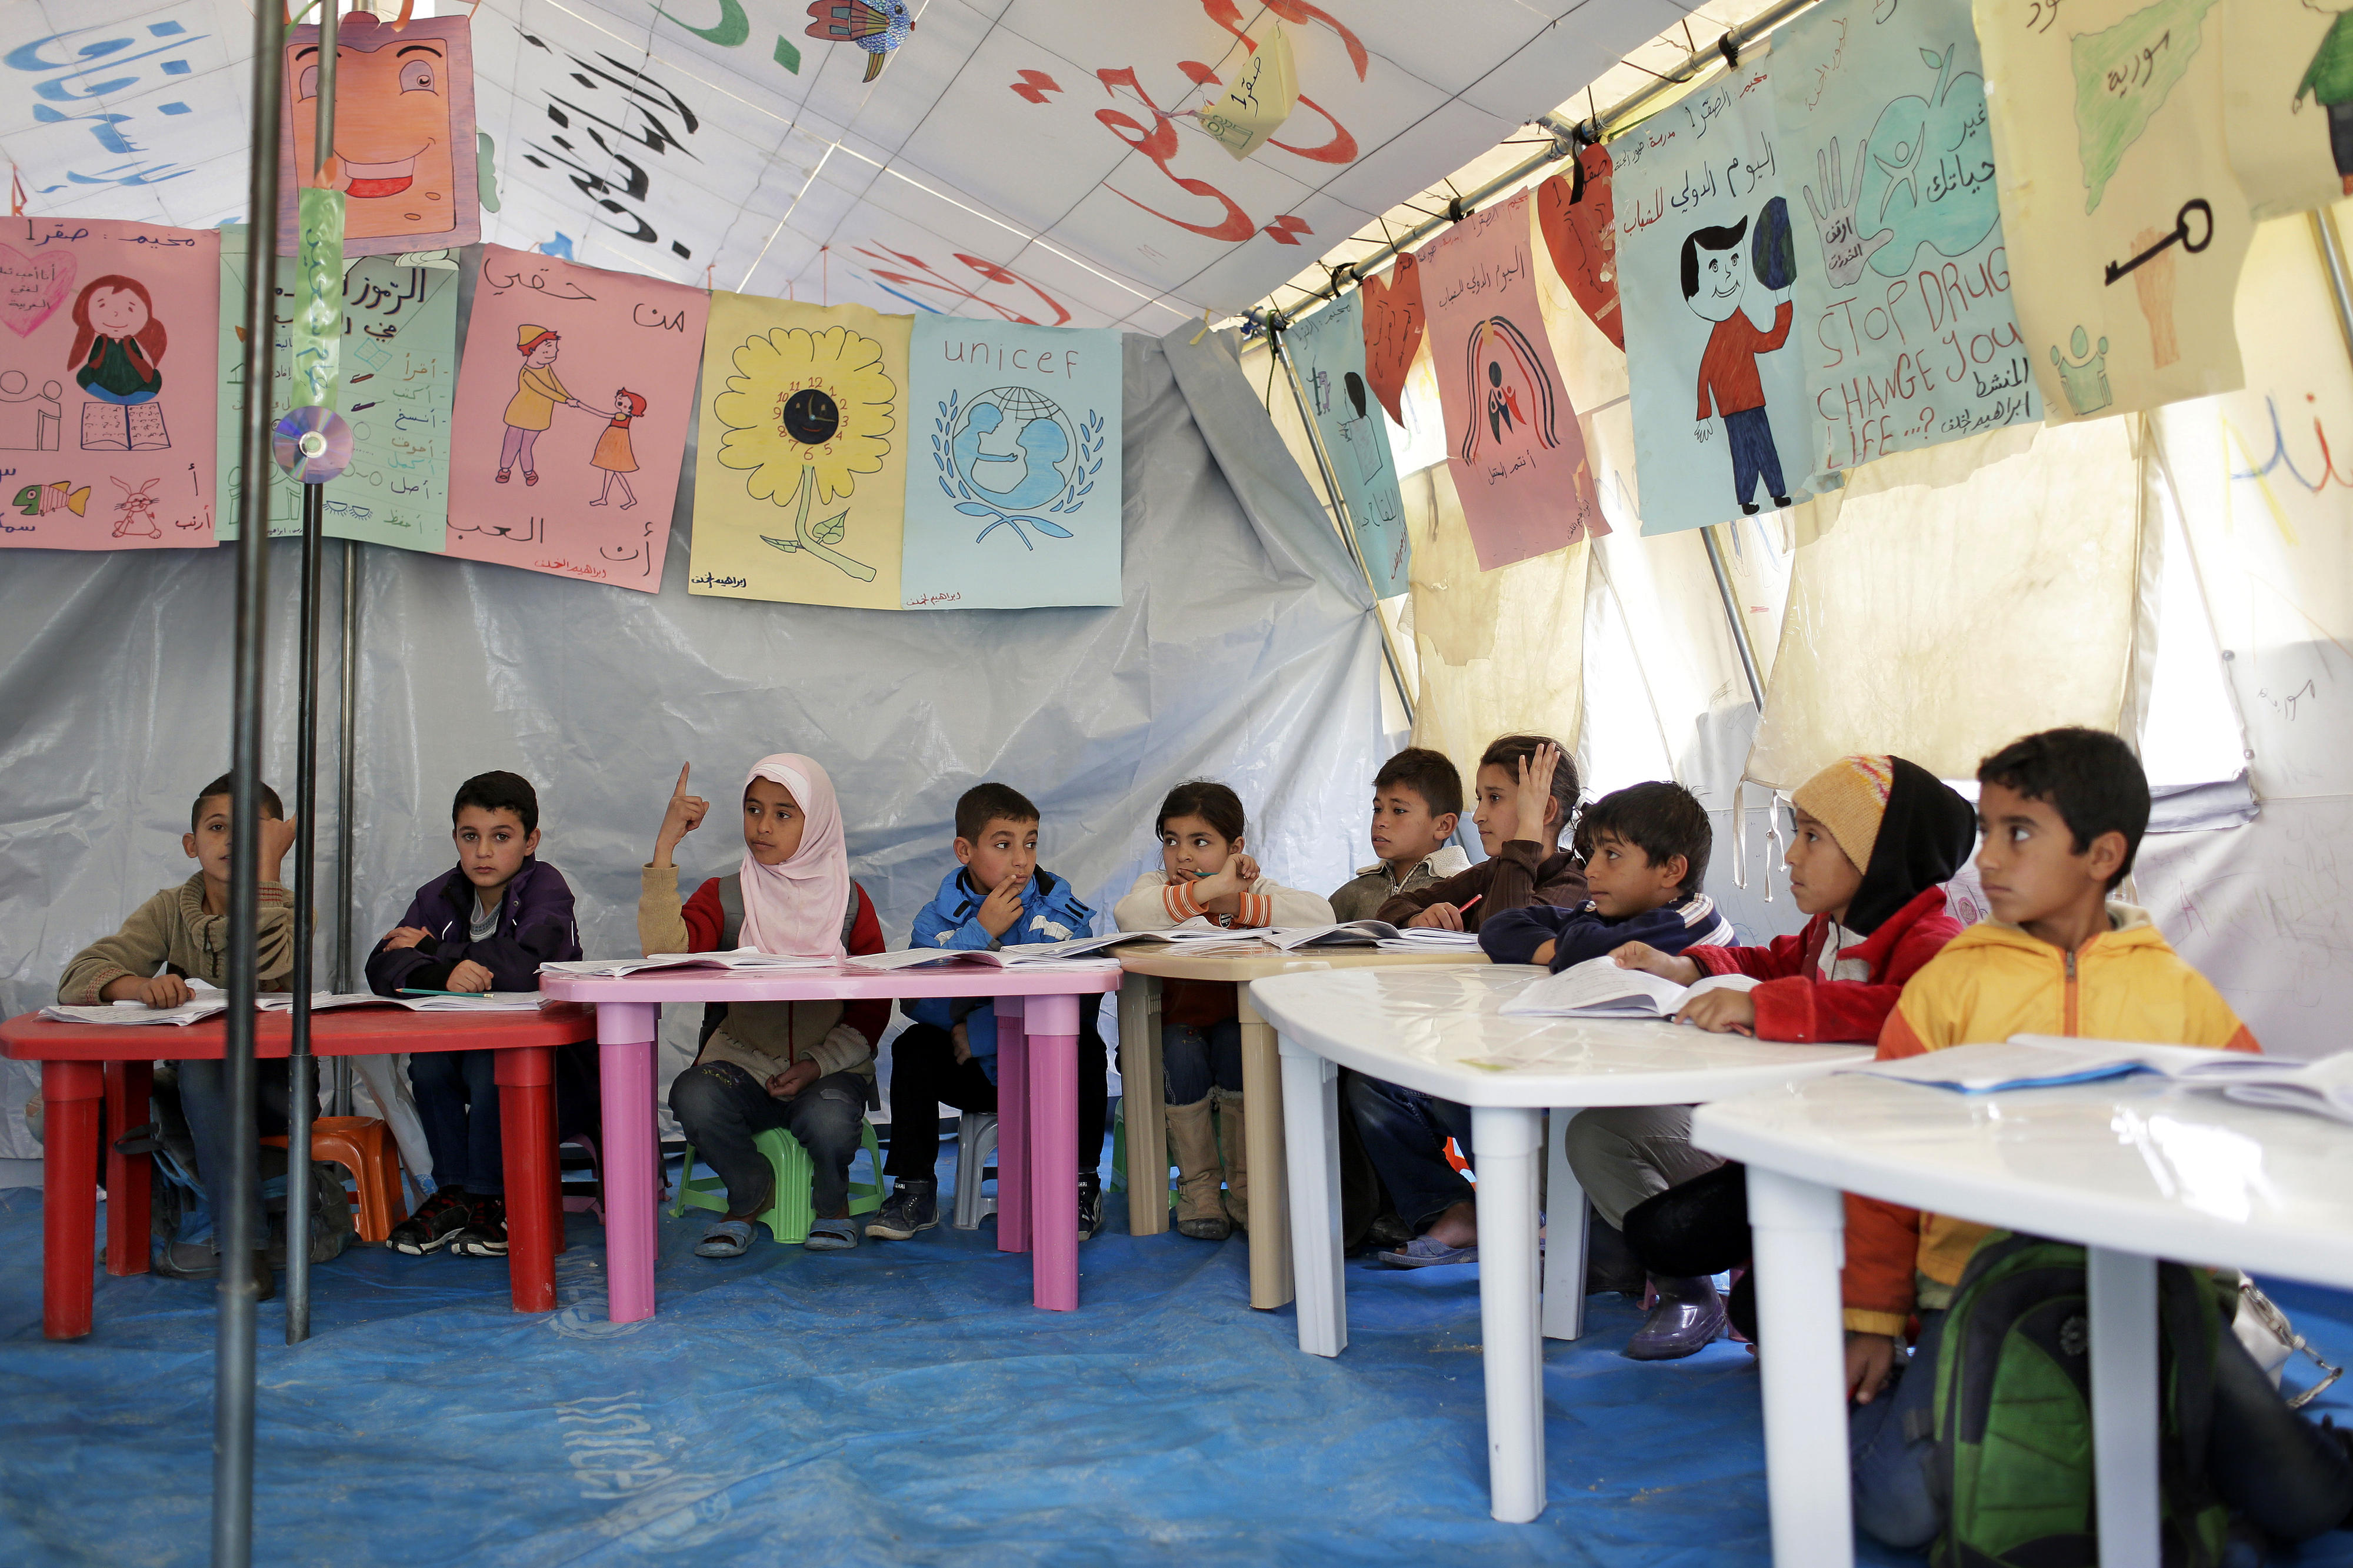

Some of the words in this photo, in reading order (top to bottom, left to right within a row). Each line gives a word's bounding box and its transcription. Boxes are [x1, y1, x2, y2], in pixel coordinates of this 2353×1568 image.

[1947, 103, 1987, 152] غير
[1727, 131, 1776, 198] اليوم
[1817, 280, 1908, 368] STOP
[1918, 246, 2011, 333] DRUG
[789, 381, 801, 392] 11
[808, 376, 823, 389] 12
[1817, 348, 1935, 426] CHANGE
[776, 391, 789, 403] 10
[829, 385, 838, 398] 1
[839, 398, 848, 410] 2
[772, 406, 782, 420] 9
[840, 415, 849, 427] 3
[777, 425, 788, 438] 8
[835, 431, 842, 441] 4
[788, 438, 800, 452] 7
[824, 443, 832, 455] 5
[804, 446, 814, 461] 6
